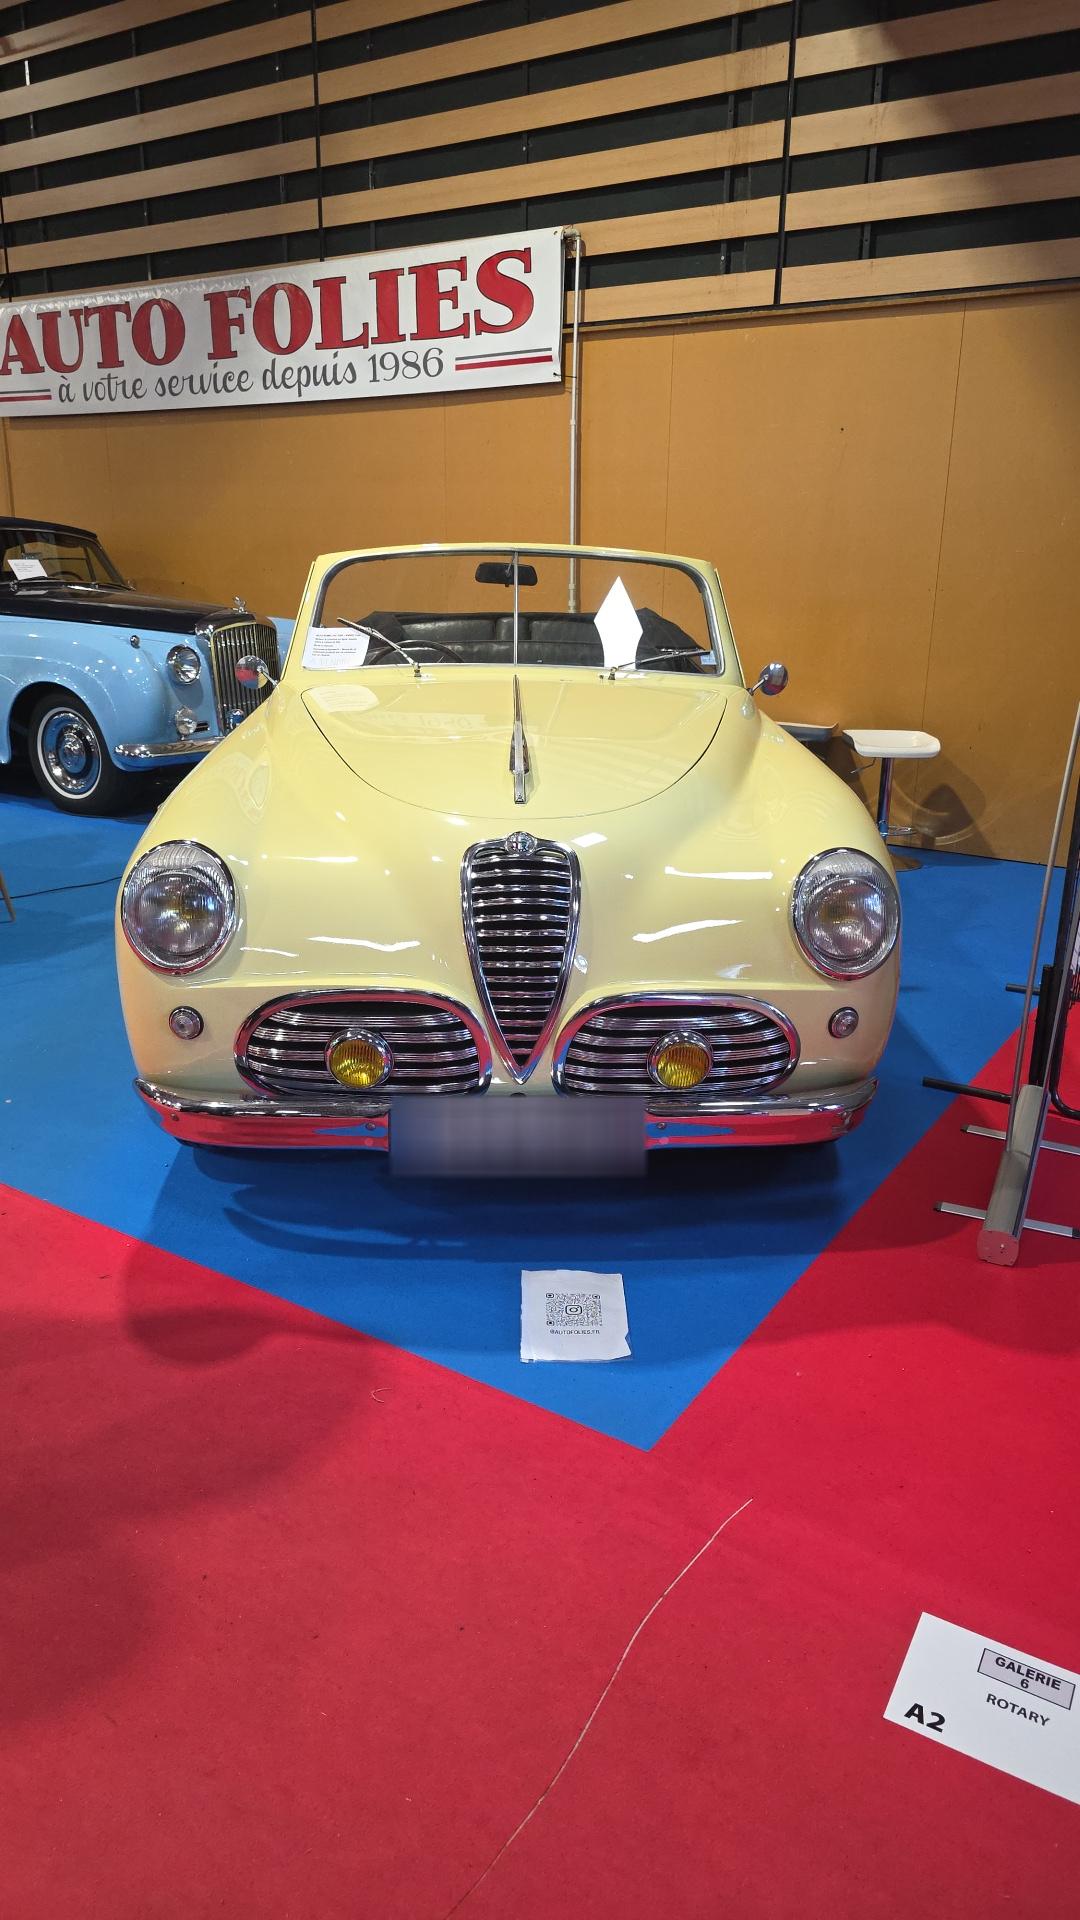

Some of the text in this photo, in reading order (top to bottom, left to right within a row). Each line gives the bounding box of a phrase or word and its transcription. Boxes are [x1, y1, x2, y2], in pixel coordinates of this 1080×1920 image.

[0, 246, 535, 376] AUTO FOLIES
[58, 347, 445, 404] à votre service depuis 1986
[995, 1656, 1062, 1691] GALERIE
[1020, 1678, 1029, 1690] 6
[904, 1703, 946, 1733] A2
[986, 1693, 1050, 1727] ROTARY
